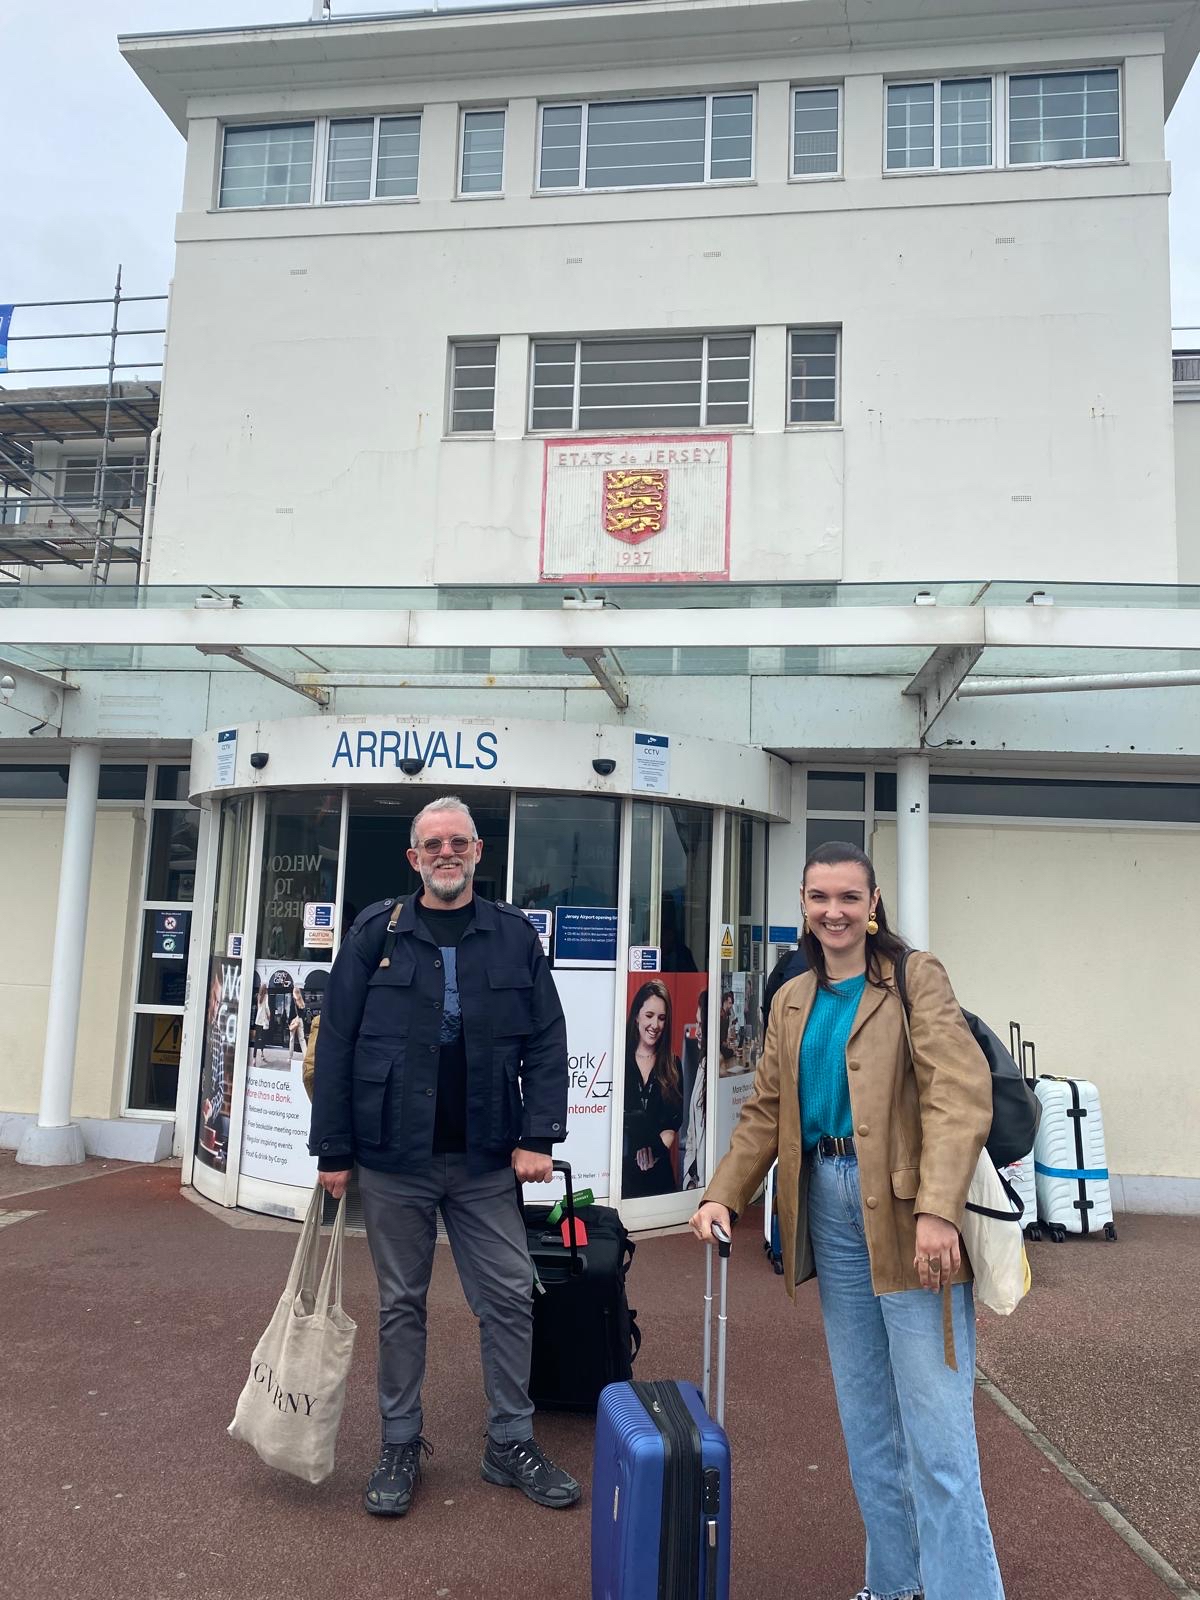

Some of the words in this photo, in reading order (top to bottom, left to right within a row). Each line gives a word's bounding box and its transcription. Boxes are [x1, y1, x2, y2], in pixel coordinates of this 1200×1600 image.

[558, 451, 613, 466] ETATS
[619, 453, 637, 464] de
[645, 448, 716, 463] JERSEY
[616, 552, 652, 566] 1937
[331, 730, 498, 770] ARRIVALS
[568, 1052, 596, 1069] ork
[286, 1112, 300, 1120] space
[273, 1126, 292, 1136] meeting
[253, 1362, 318, 1416] GVRNY
